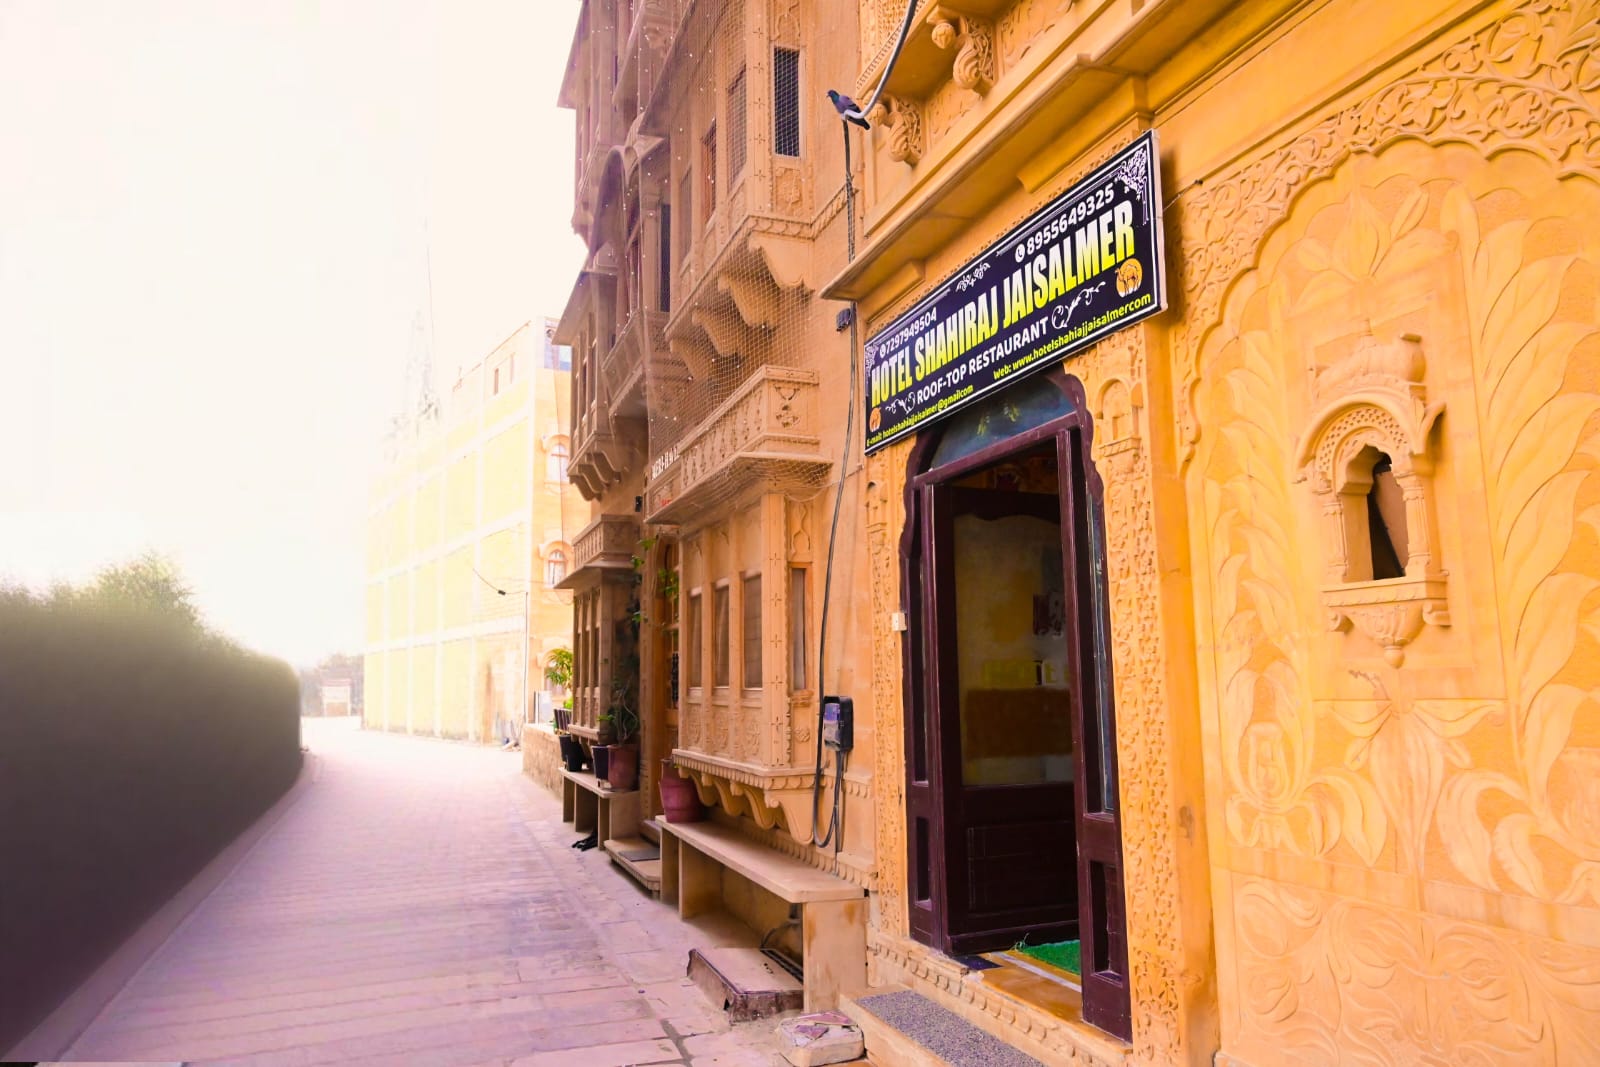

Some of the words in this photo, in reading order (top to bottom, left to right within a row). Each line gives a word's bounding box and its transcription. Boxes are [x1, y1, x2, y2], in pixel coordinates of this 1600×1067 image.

[1026, 183, 1115, 255] 8955649325
[871, 345, 913, 408] HOTEL
[914, 285, 999, 382] SHAHIRAJ
[1003, 200, 1135, 328] JAISALMER
[886, 306, 937, 354] 7297949504
[917, 365, 967, 405] ROOF-TOP
[969, 316, 1049, 375] RESTAURANT
